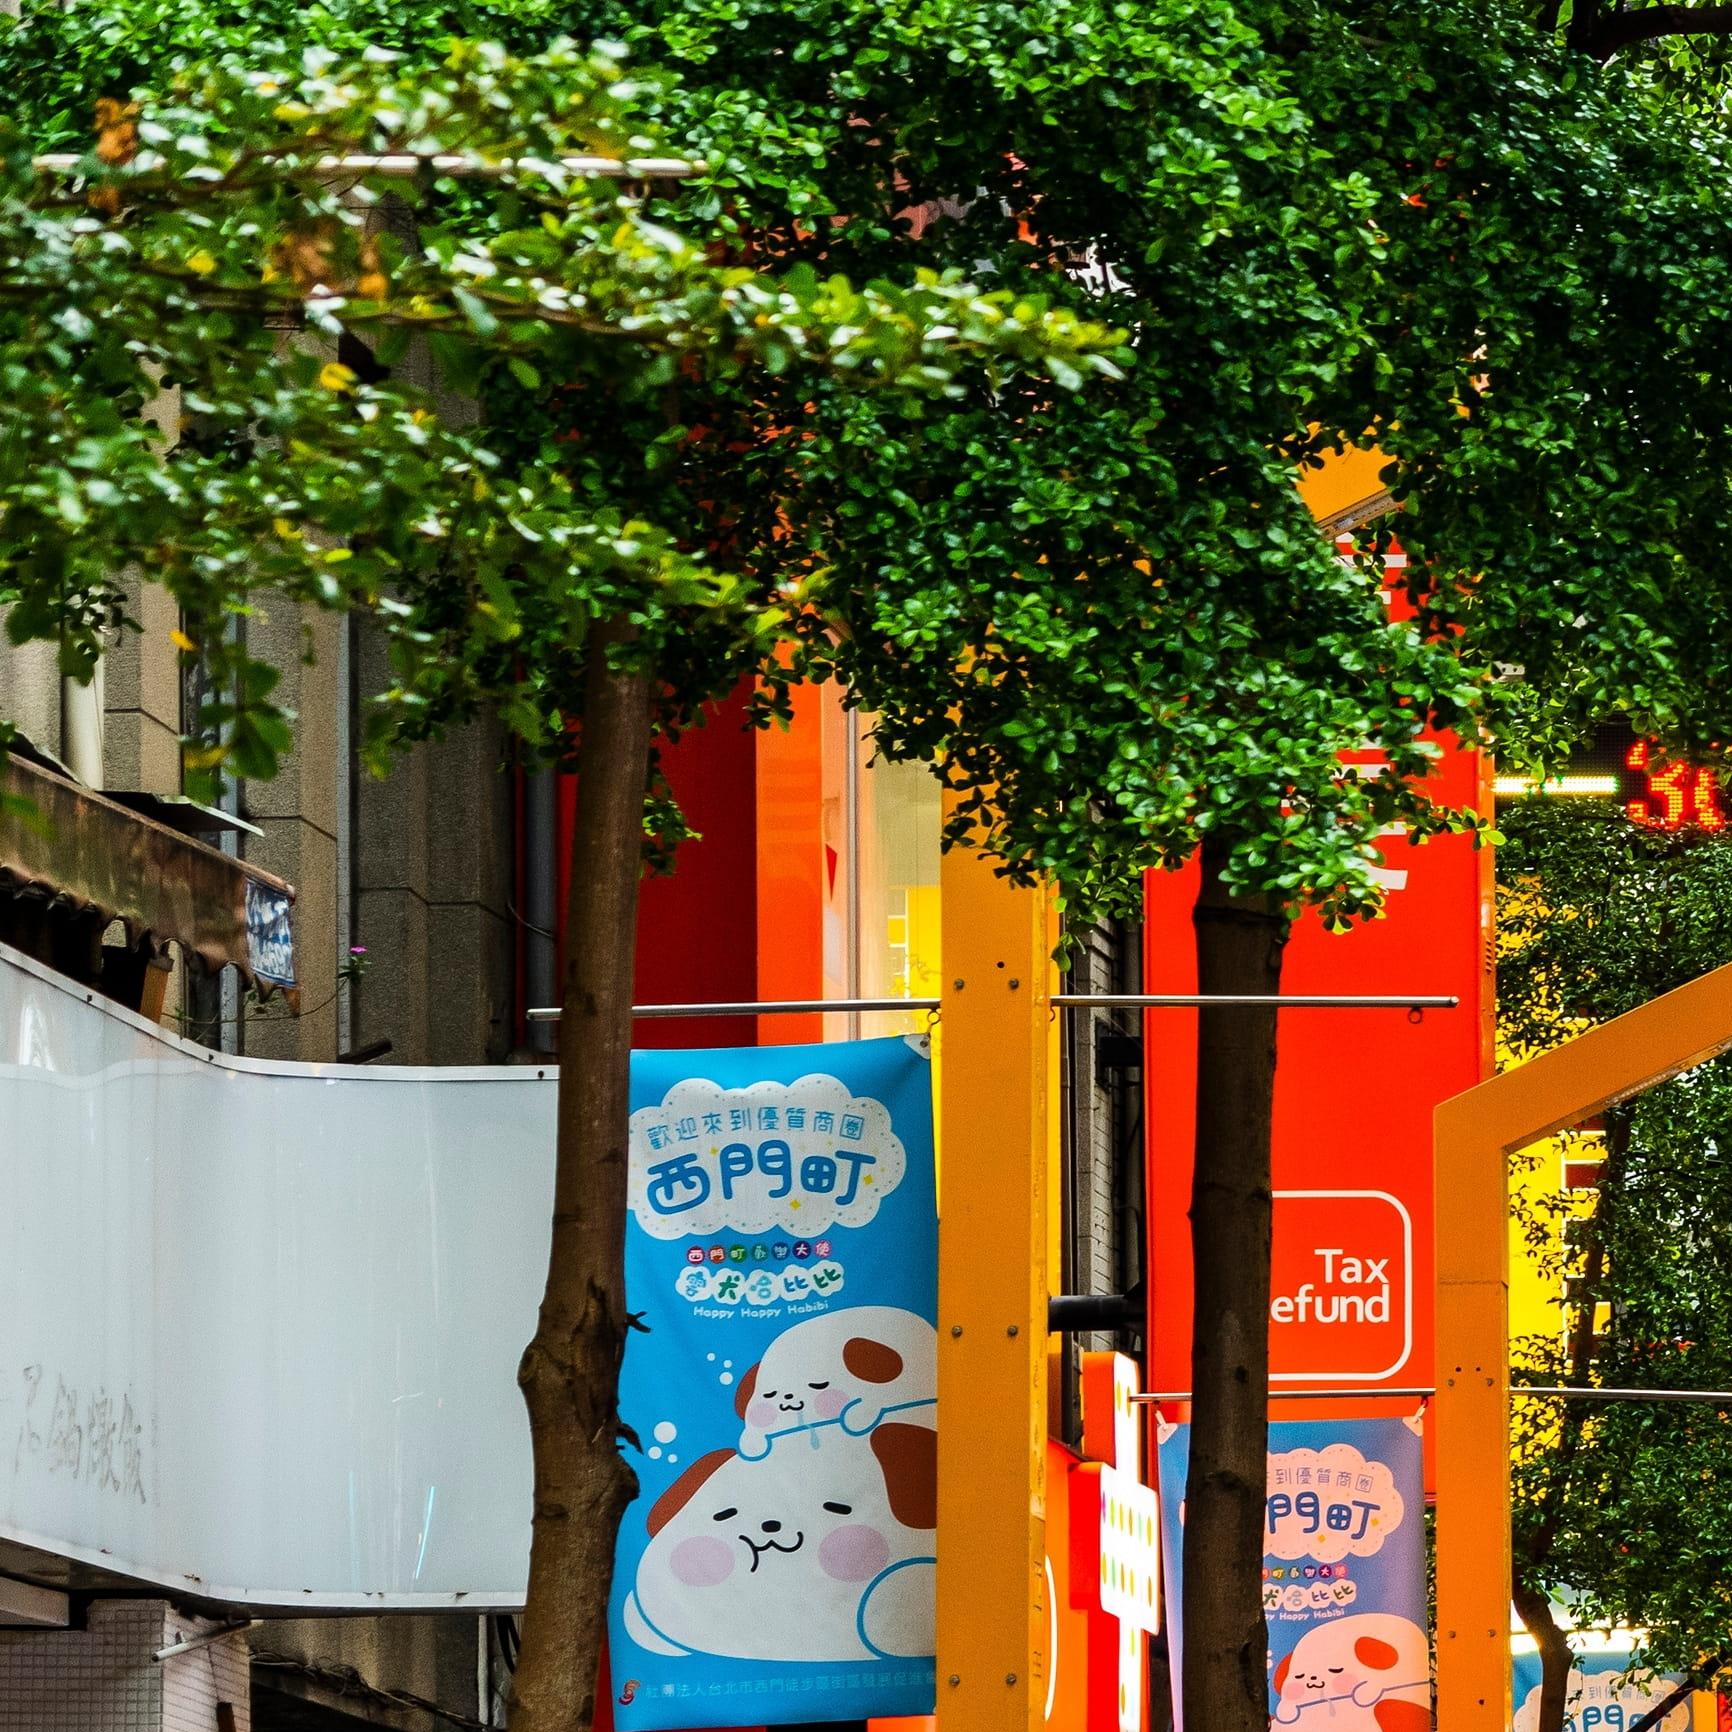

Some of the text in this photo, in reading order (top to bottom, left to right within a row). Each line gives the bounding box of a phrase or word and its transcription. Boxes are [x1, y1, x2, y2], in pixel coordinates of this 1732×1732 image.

[647, 1107, 865, 1150] 歡迎來到優質商圈
[647, 1140, 876, 1215] 西門町
[1315, 1249, 1389, 1284] Tax
[694, 1301, 829, 1319] Happy Happy Habibi
[1272, 1287, 1391, 1325] efund
[1267, 1467, 1374, 1493] 到優質商圈
[1266, 1491, 1381, 1541] 門町
